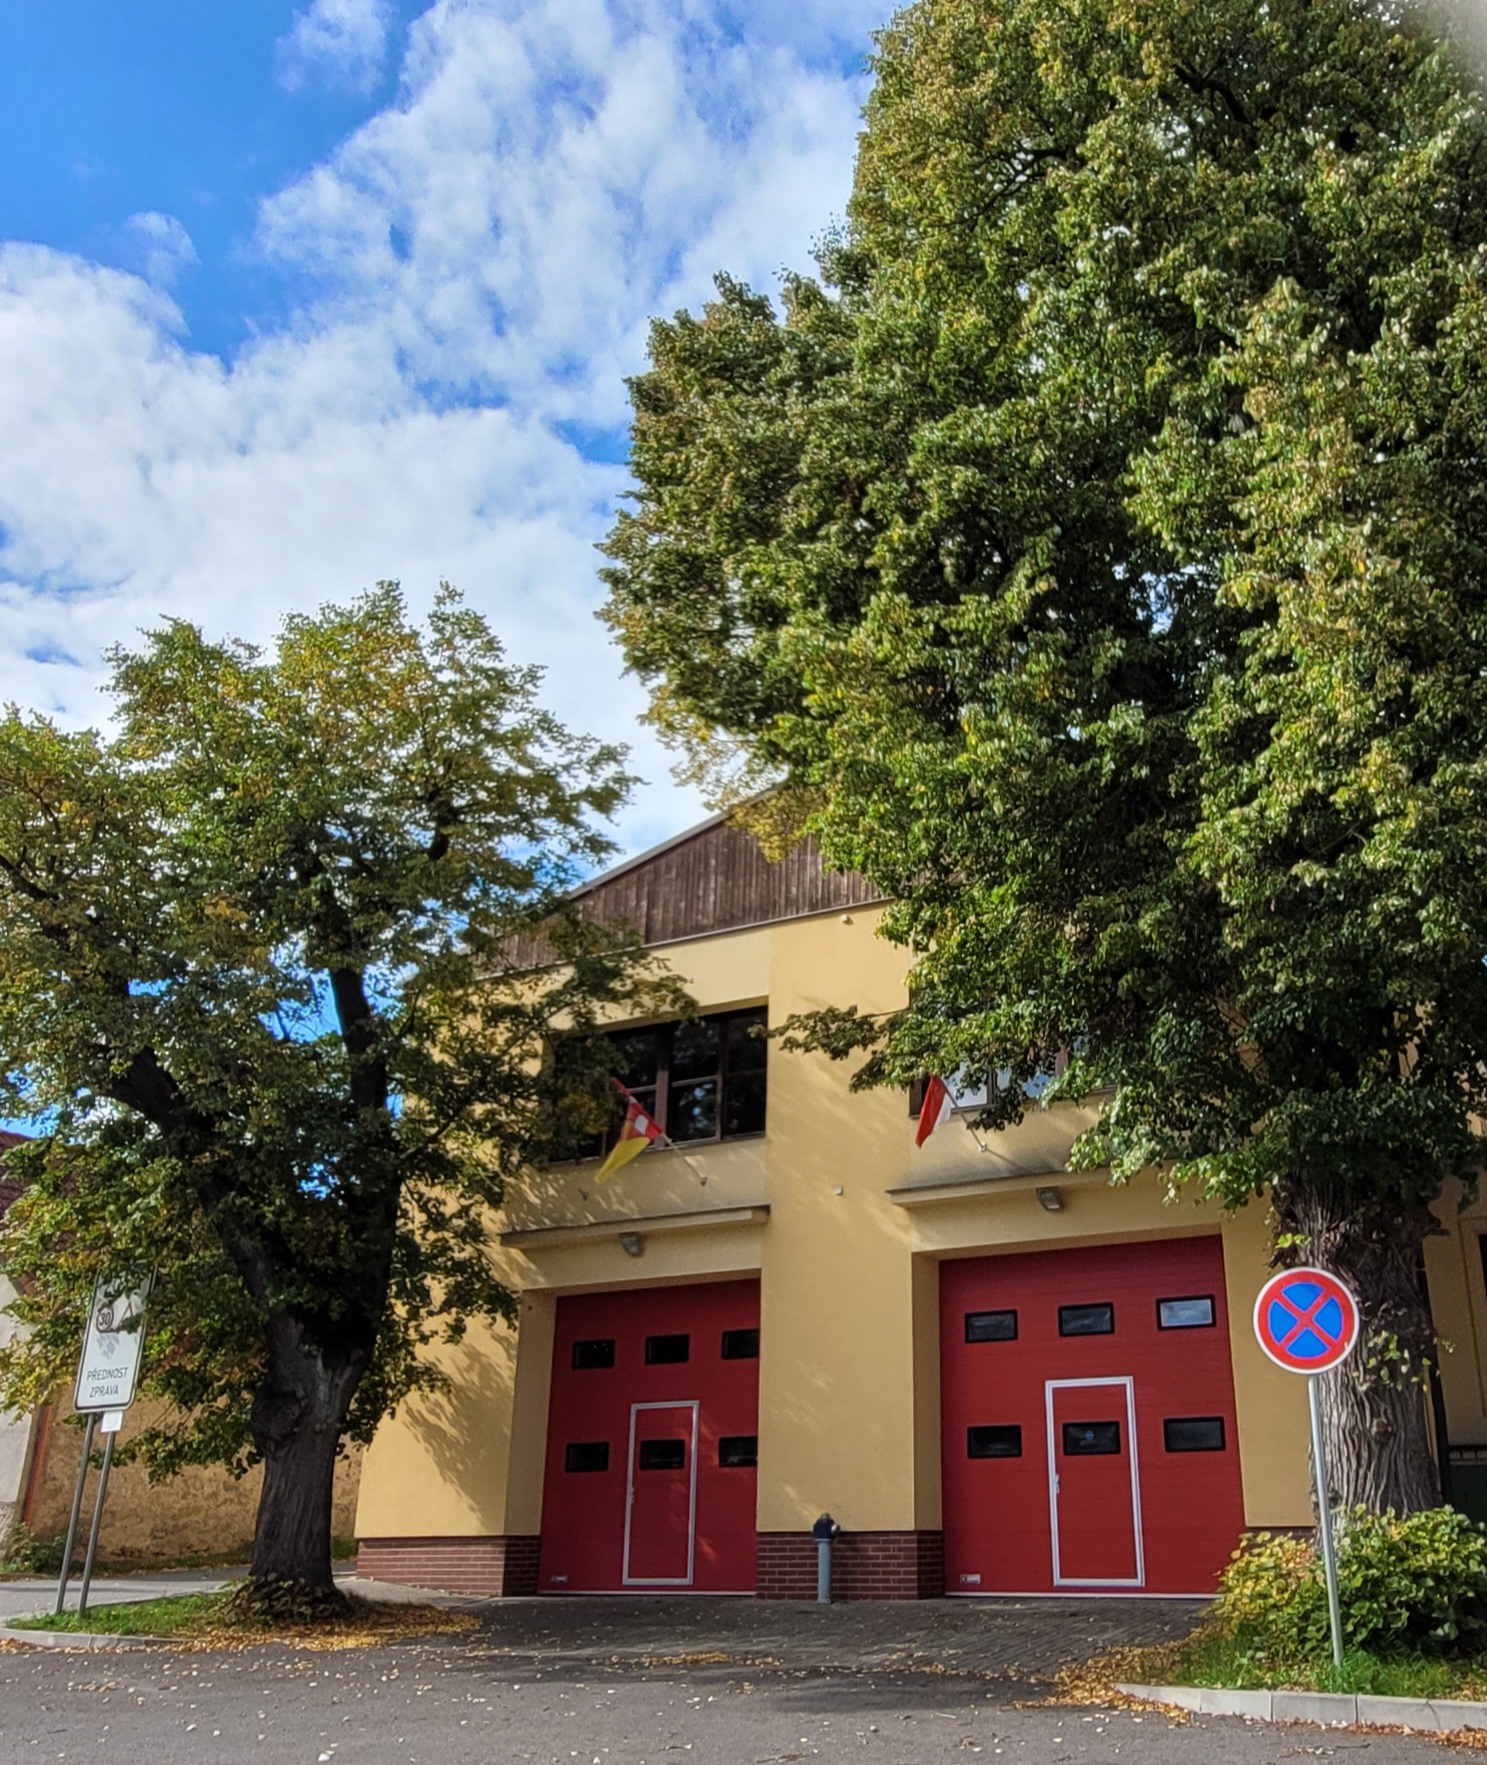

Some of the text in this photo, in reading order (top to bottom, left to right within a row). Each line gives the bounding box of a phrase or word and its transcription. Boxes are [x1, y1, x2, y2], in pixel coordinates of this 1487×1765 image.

[99, 1311, 111, 1326] 30
[87, 1366, 129, 1381] PŘEDNOST
[89, 1385, 119, 1398] ZPRAVA
